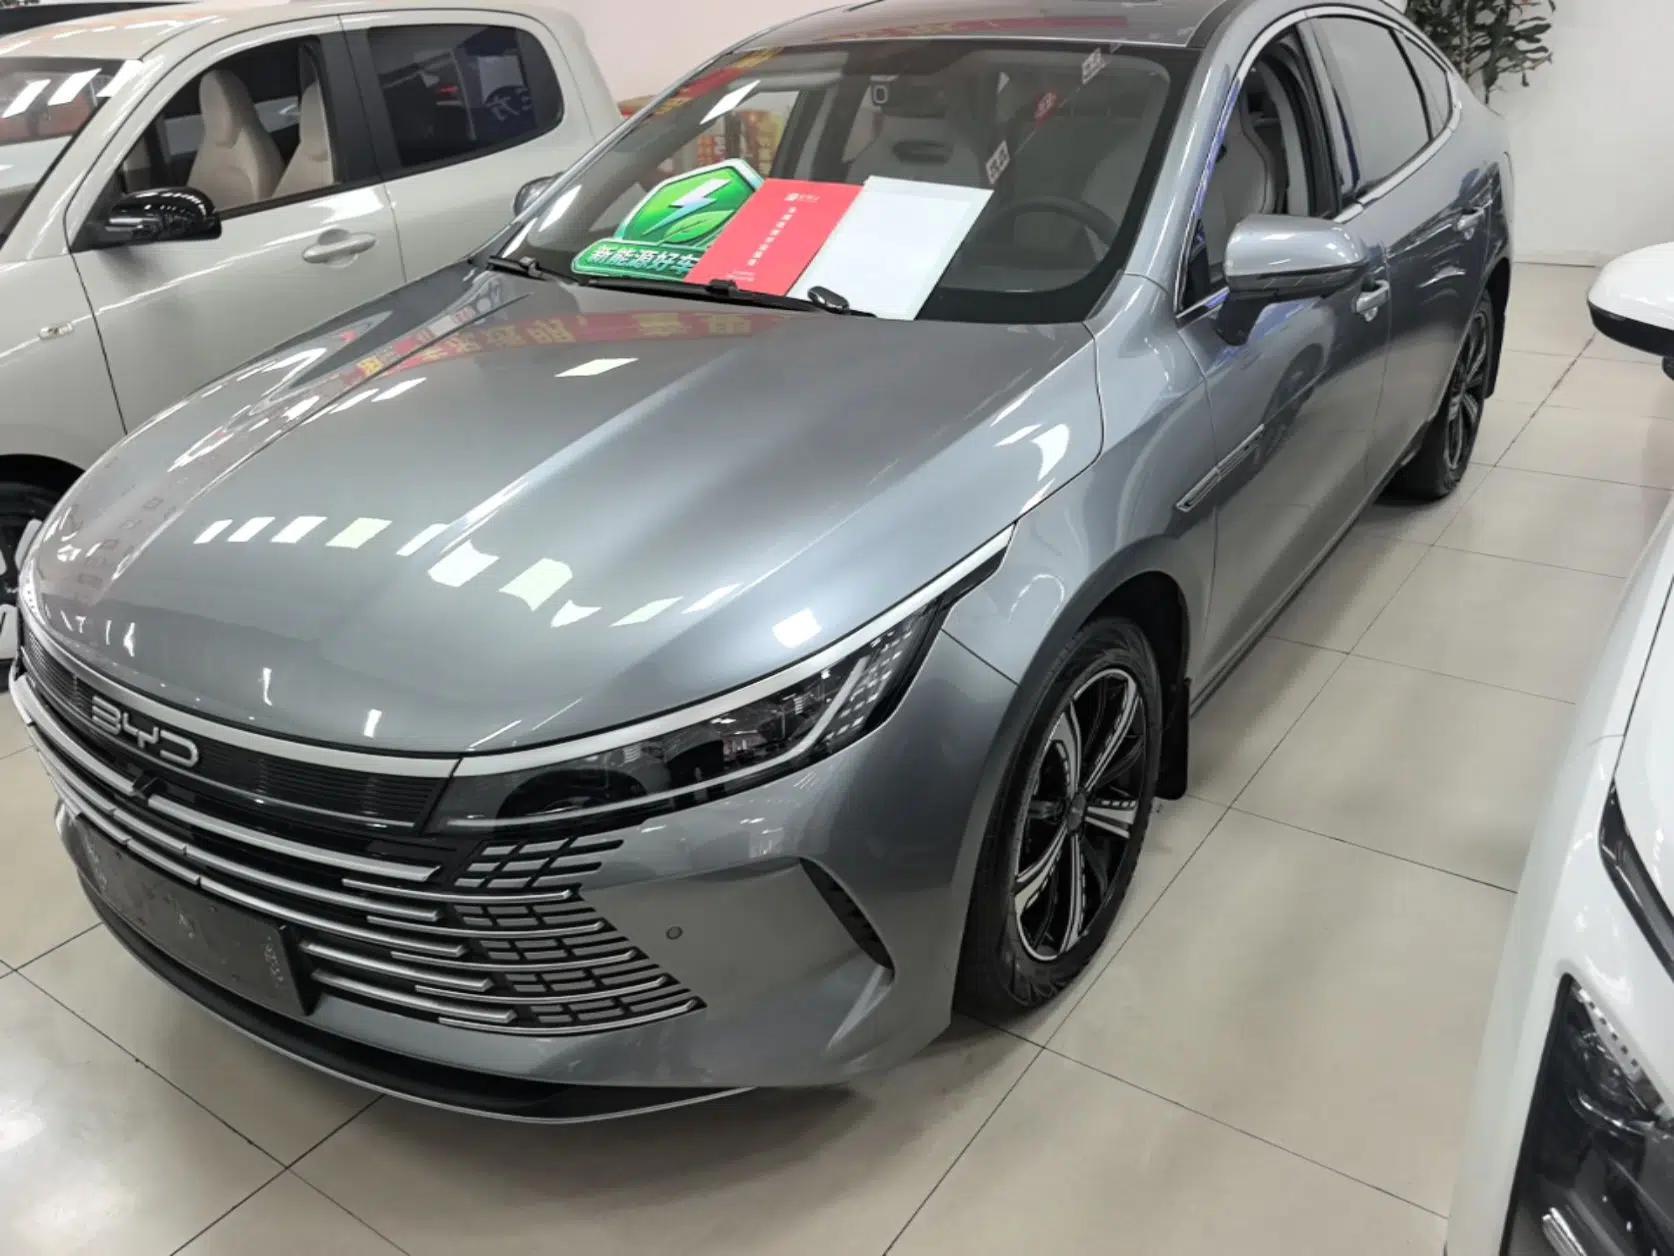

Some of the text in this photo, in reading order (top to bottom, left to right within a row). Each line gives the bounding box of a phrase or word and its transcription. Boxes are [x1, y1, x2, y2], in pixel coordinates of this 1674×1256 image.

[590, 246, 700, 274] 新能源好车
[92, 696, 199, 767] BYD
